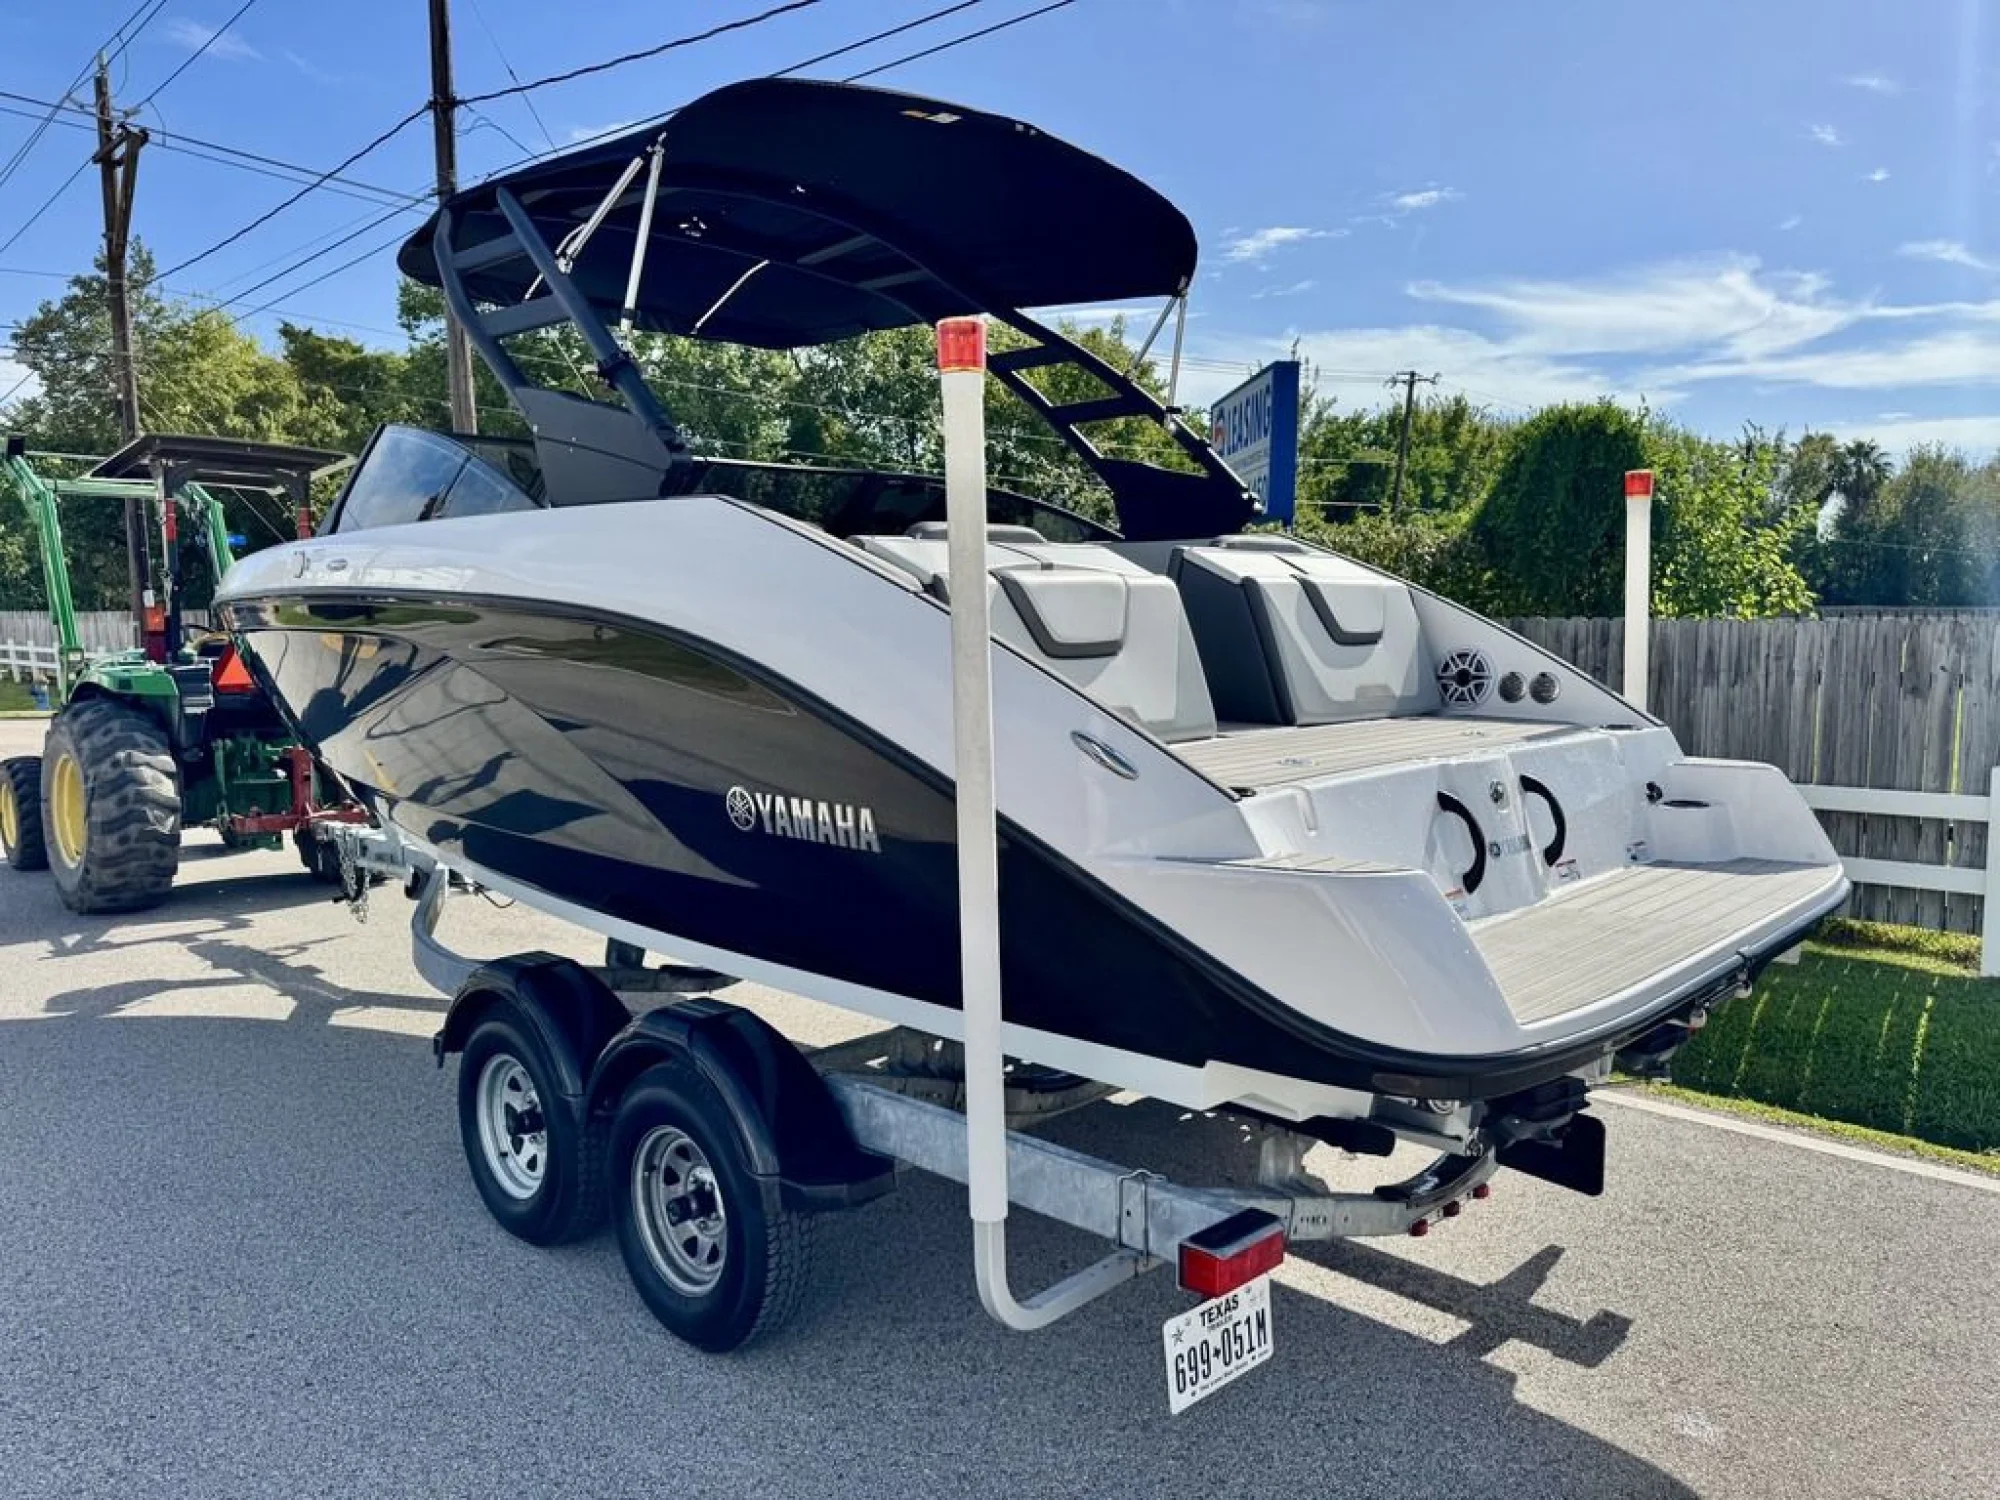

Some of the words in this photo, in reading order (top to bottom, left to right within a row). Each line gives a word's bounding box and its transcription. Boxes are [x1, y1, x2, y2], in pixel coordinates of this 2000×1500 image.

[1227, 383, 1270, 456] LEASING
[755, 793, 881, 853] YAMAHA
[1200, 1295, 1239, 1327] TEXAS
